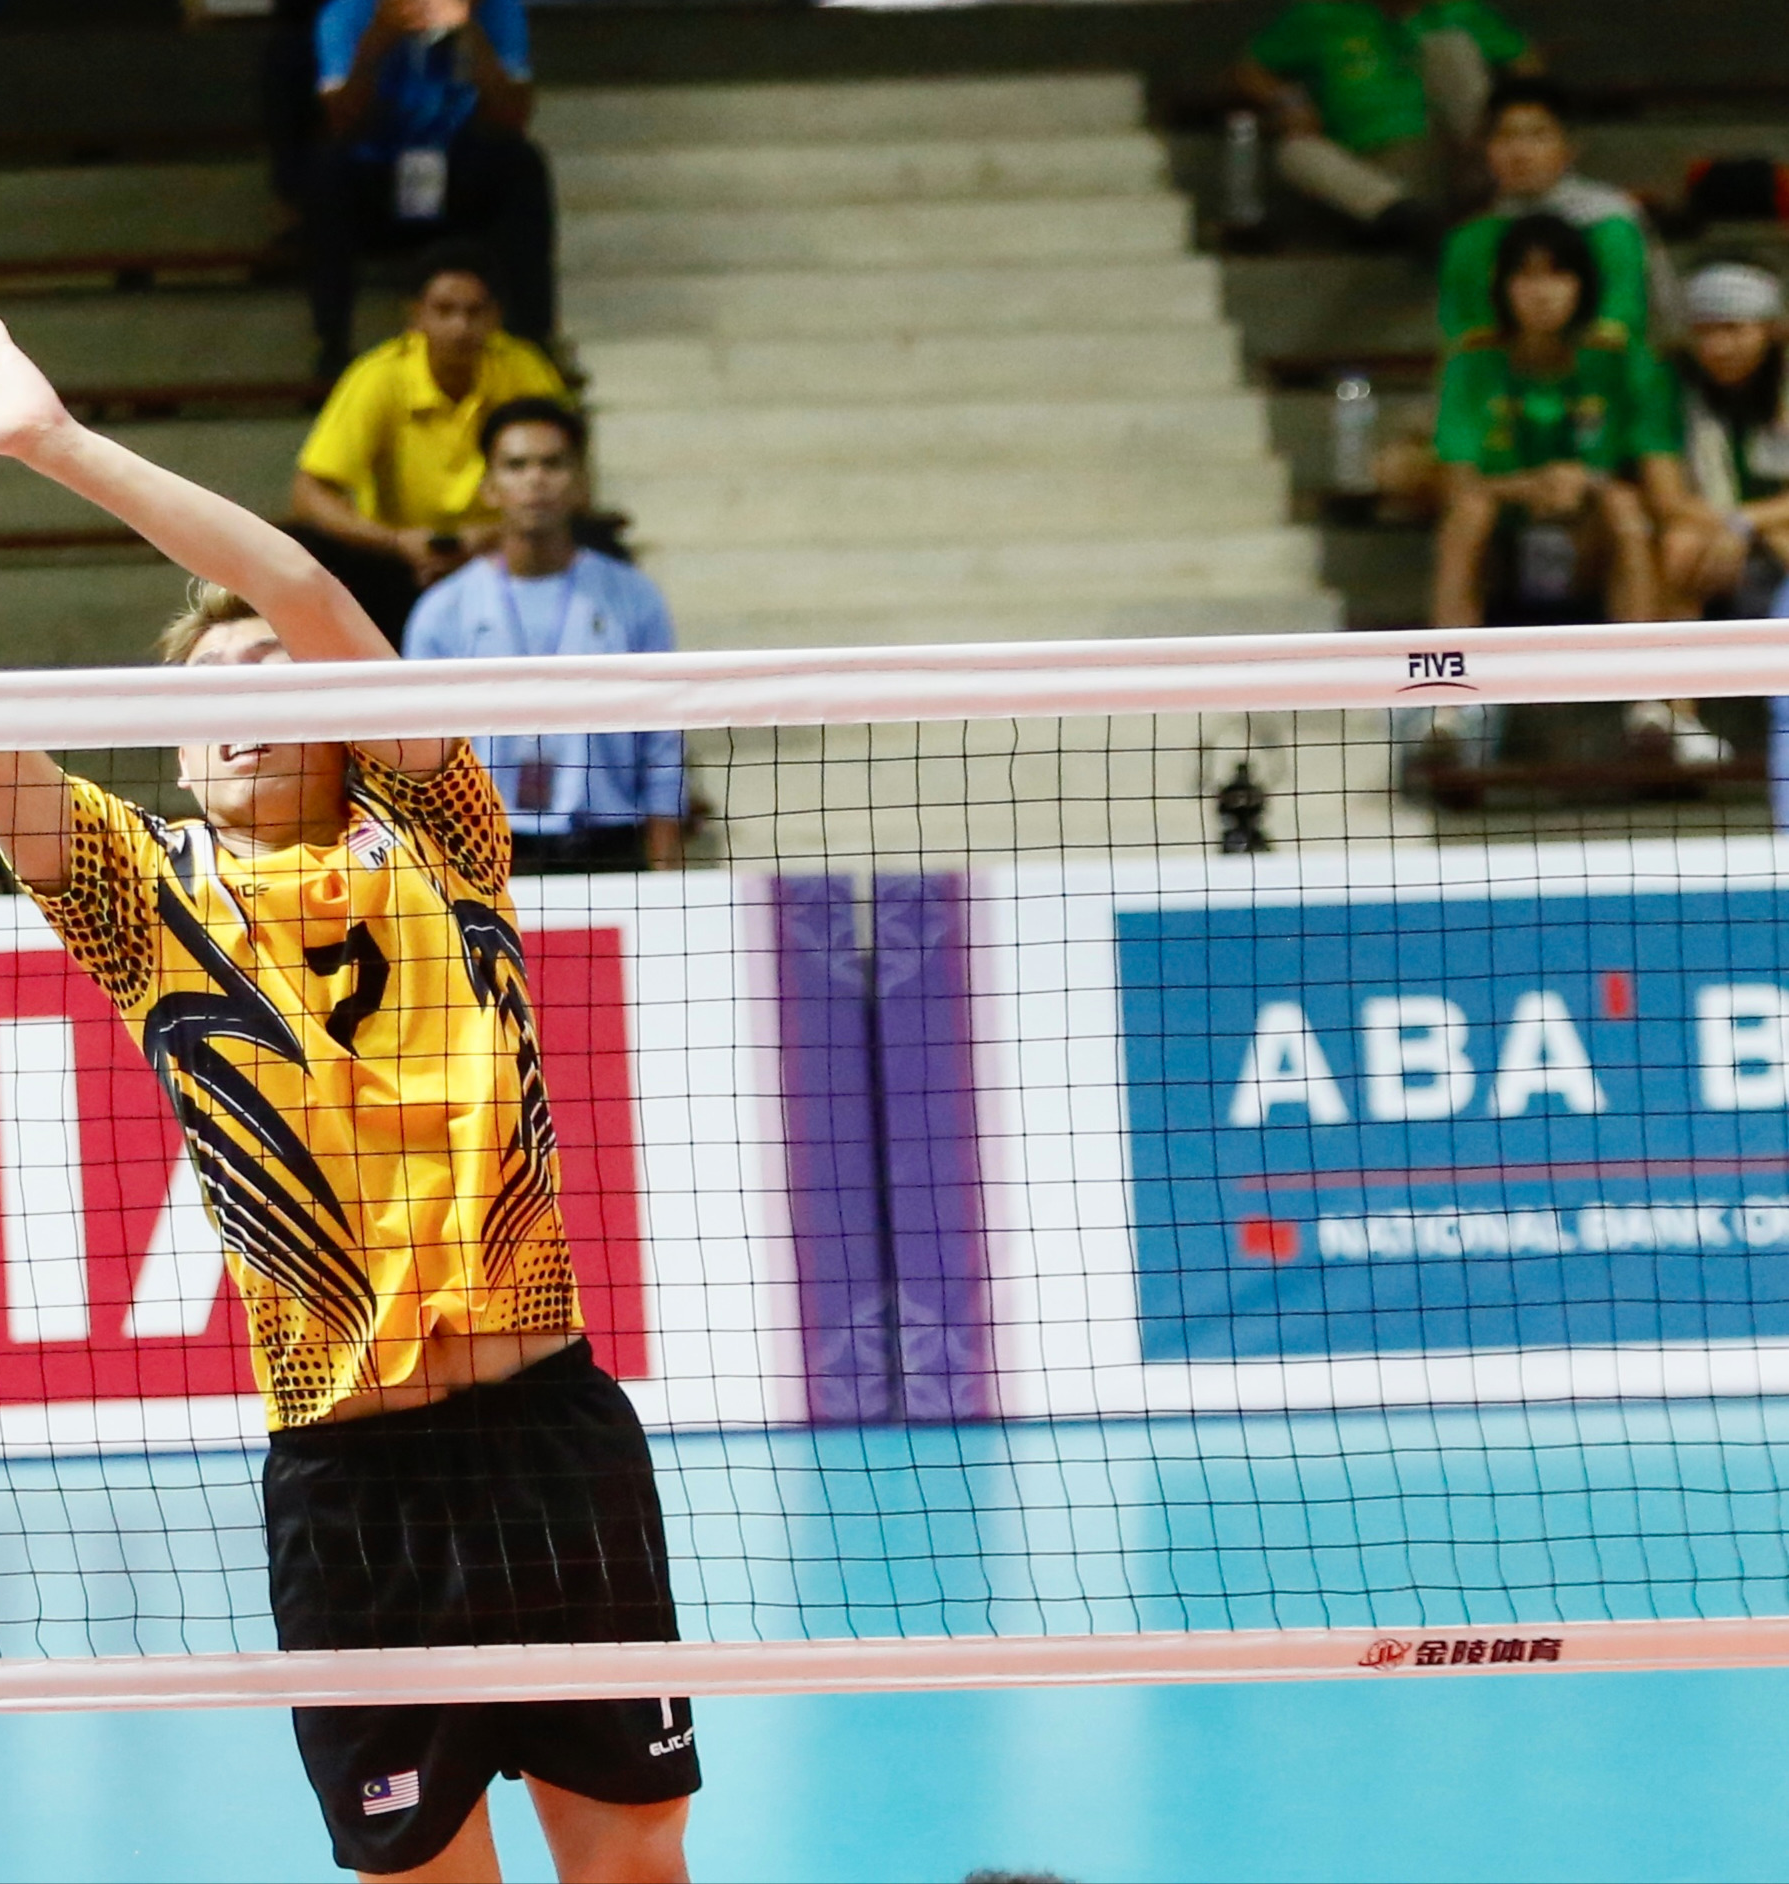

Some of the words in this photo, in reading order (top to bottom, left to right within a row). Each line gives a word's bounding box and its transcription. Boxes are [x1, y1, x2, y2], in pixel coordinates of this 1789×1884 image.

[1408, 652, 1466, 678] FIVB
[1318, 1207, 1579, 1260] NATIONAL
[1579, 1201, 1732, 1251] BANK
[1415, 1638, 1563, 1666] 金陵体育
